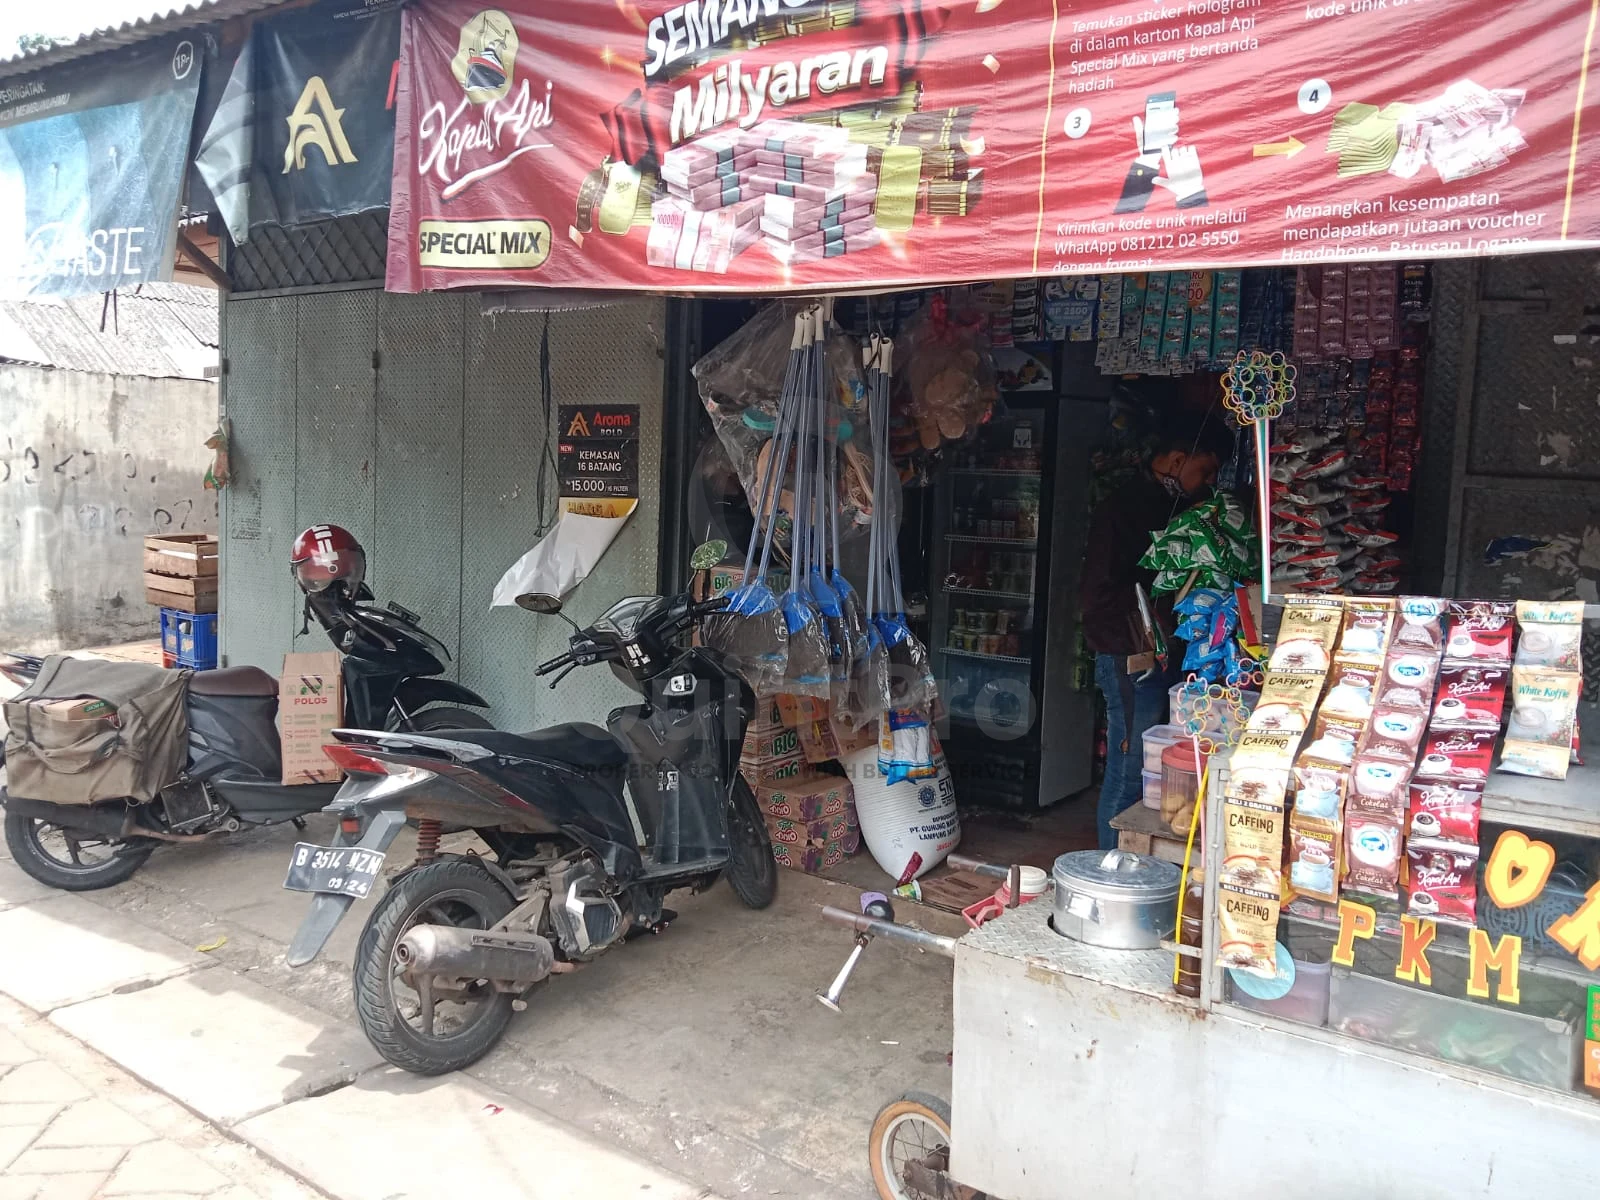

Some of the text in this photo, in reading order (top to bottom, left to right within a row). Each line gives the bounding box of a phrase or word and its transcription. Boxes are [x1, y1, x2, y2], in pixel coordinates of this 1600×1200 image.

[1072, 0, 1261, 33] Temukan sticker hologram
[1305, 1, 1345, 20] kode
[1070, 15, 1255, 54] di dalam karton Kapal Api
[1070, 36, 1259, 76] Special Mix yang bertanda
[671, 46, 888, 143] Milyaran
[1069, 77, 1114, 94] hadiah
[1309, 88, 1319, 103] 4
[418, 78, 553, 182] Kapal Api
[1073, 115, 1081, 129] 3
[1285, 191, 1499, 220] Menangkan kesempatan
[1056, 207, 1247, 237] Kirimkan kode unik melalui
[1283, 209, 1547, 244] mendapatkan jutaan voucher
[420, 231, 542, 255] SPECIAL MIX
[1055, 229, 1239, 257] WhatApp 081212 02 5550
[593, 411, 631, 426] Aroma
[600, 428, 623, 437] BOLD
[560, 445, 573, 453] NEW
[579, 450, 620, 460] KEMASAN
[577, 462, 622, 472] 16 BATANG
[1268, 677, 1314, 690] CAFFINO
[1448, 682, 1474, 695] Kapal
[1518, 684, 1570, 699] White Koffie
[294, 697, 328, 705] POLOS
[772, 729, 798, 756] BIG
[1243, 737, 1289, 750] CAFFINO
[1420, 790, 1466, 808] Kapal Api
[1229, 813, 1274, 834] CAFFINO
[296, 848, 308, 867] B
[312, 851, 344, 869] 3514
[1418, 871, 1462, 889] Kapal Api
[1223, 884, 1237, 892] BELI
[1244, 888, 1270, 899] GRATIS
[1226, 899, 1270, 922] CAFFINO
